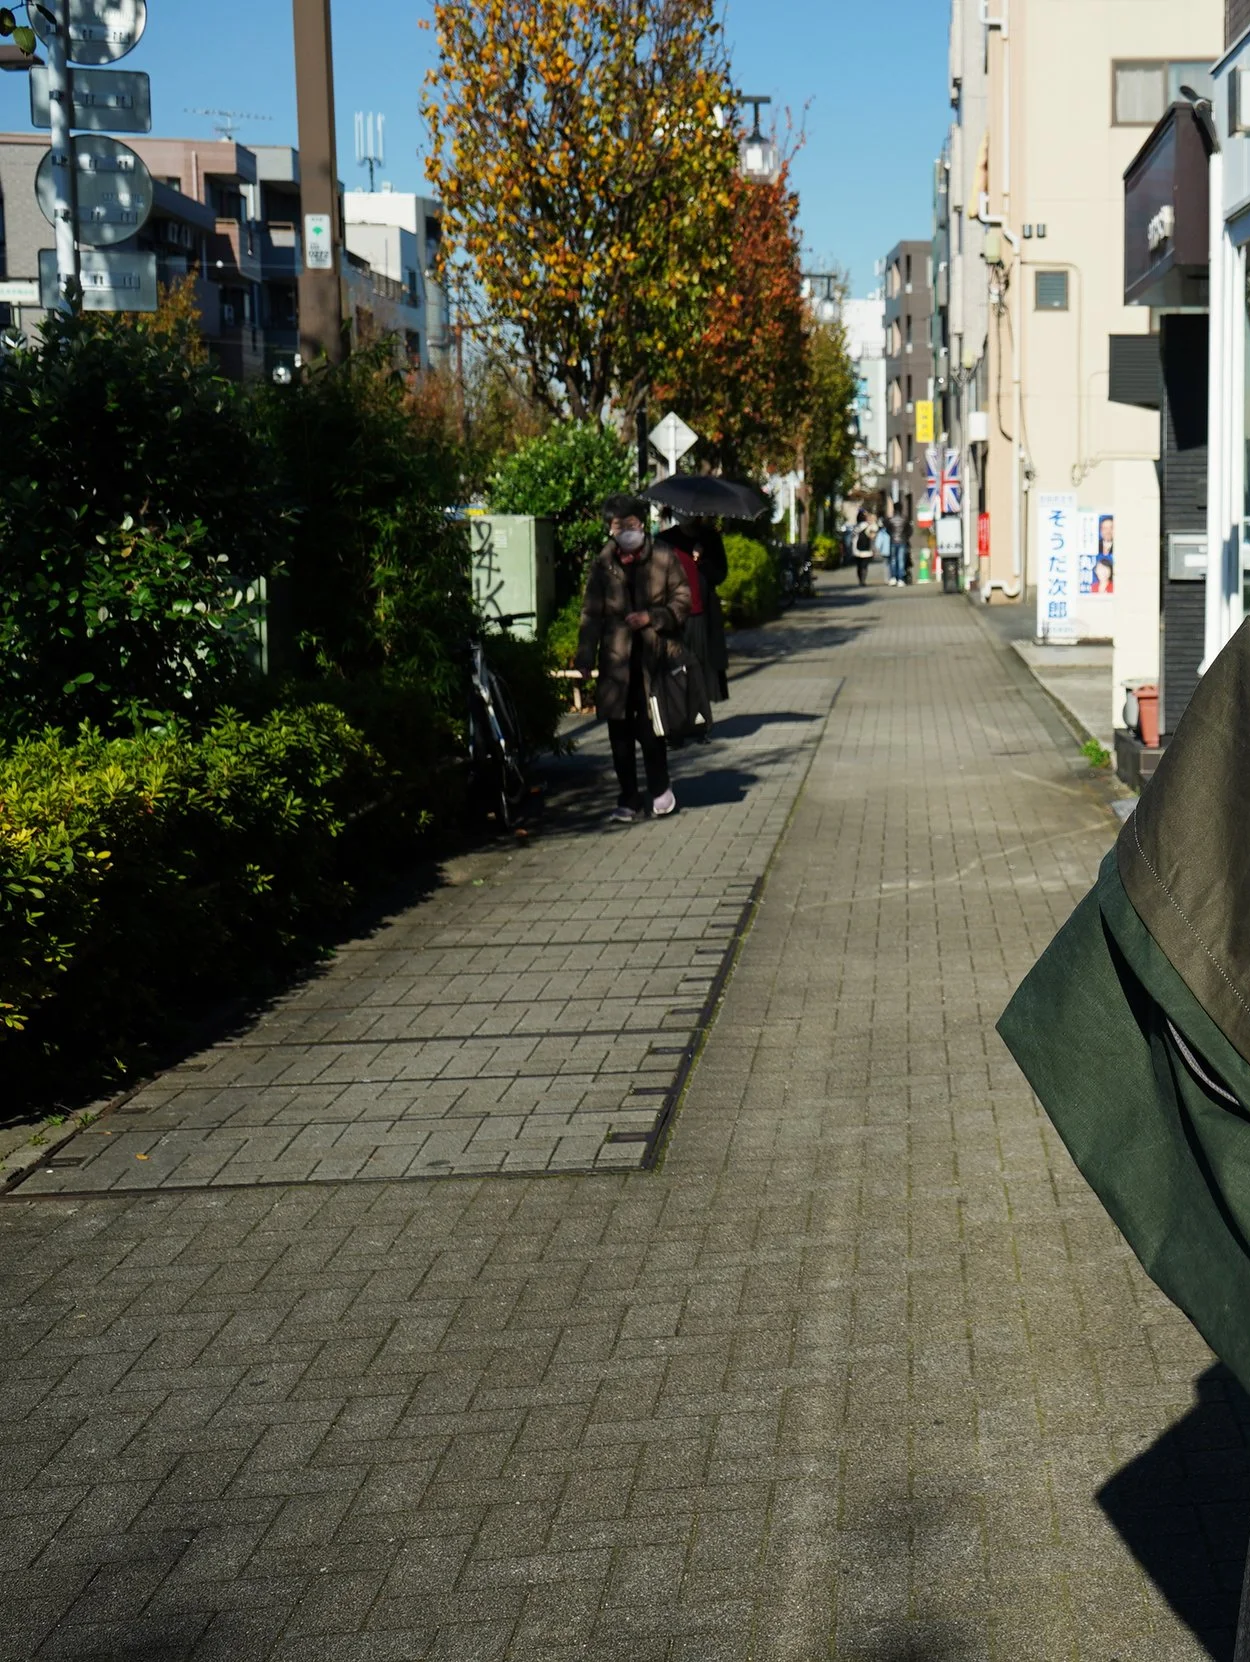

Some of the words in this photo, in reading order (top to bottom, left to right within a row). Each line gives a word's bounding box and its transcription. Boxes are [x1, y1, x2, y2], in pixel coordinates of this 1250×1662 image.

[1048, 509, 1068, 618] そうだ次郎
